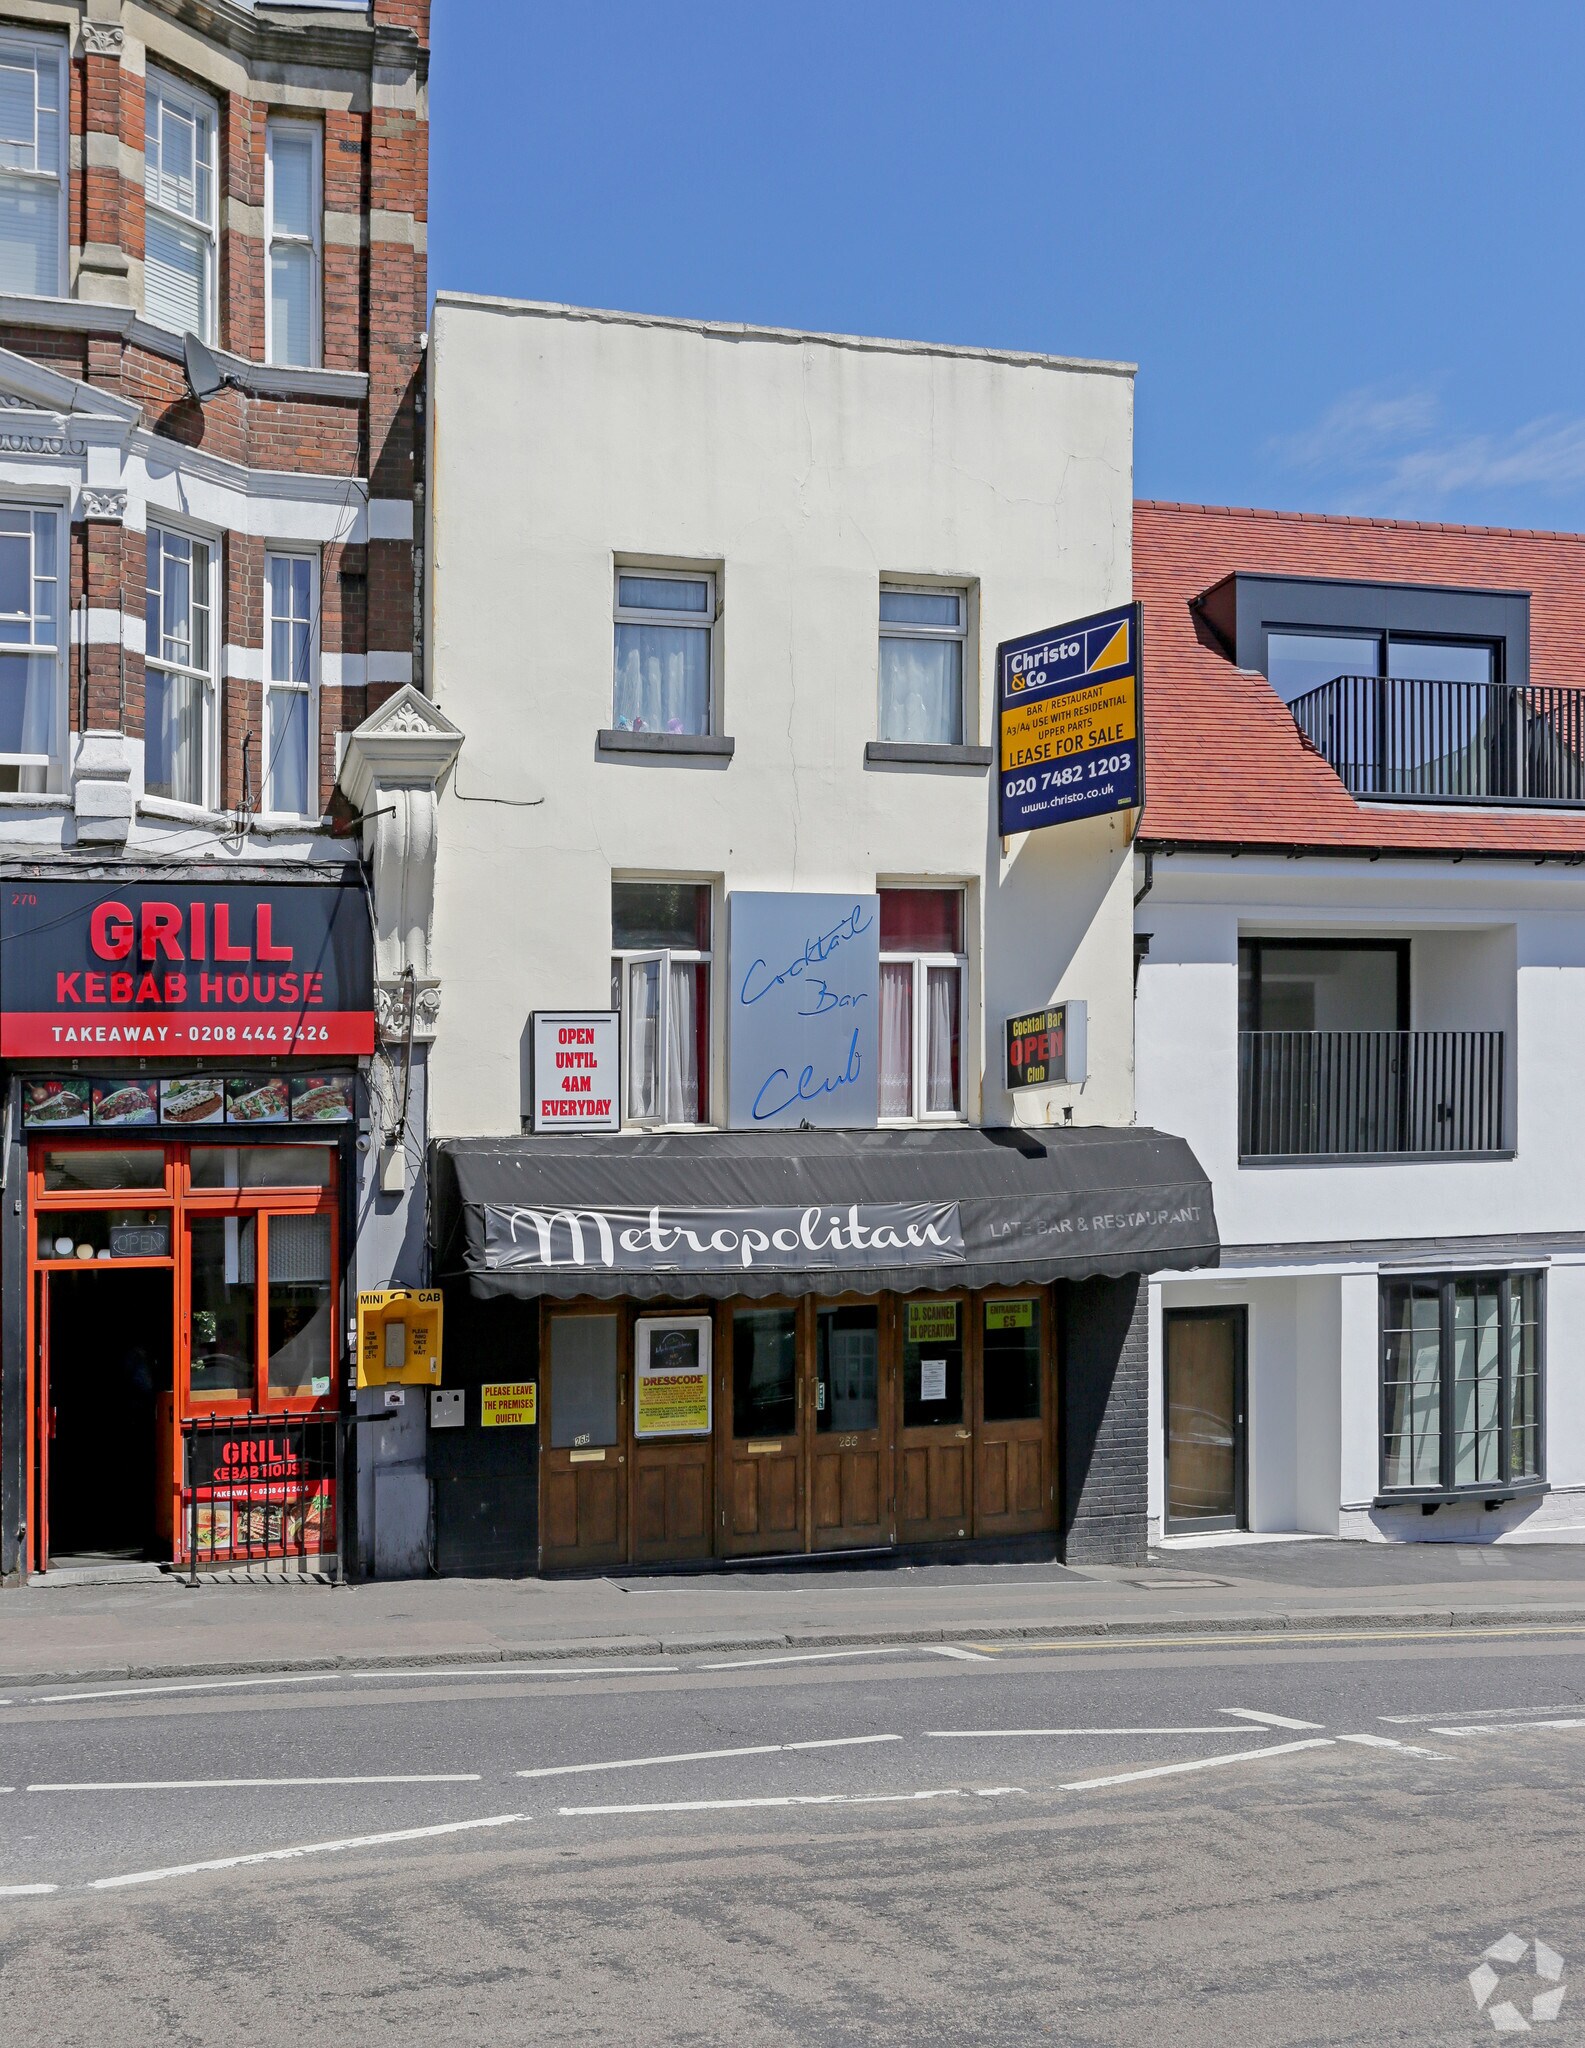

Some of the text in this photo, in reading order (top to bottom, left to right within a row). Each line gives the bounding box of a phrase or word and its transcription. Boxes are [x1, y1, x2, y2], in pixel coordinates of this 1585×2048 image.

[1011, 640, 1080, 672] Christo
[1011, 669, 1046, 691] &Co
[1026, 703, 1042, 716] BAR
[1051, 686, 1103, 710] RESTAURANT
[1006, 694, 1127, 736] A3/A4 USE WITH RESIDENTIAL
[1038, 718, 1093, 740] UPPER PARTS
[1009, 723, 1124, 768] LEASE FOR SALE
[1006, 753, 1131, 798] 020 7482 1203
[1021, 783, 1114, 814] www.christo.co.uk
[12, 893, 37, 905] 270
[90, 901, 293, 962] GRILL
[741, 905, 873, 1005] Cocktail
[56, 971, 323, 1004] KEBAB HOUSE
[798, 979, 867, 1015] Bar
[1013, 1011, 1063, 1037] Cocktail Bar
[52, 1026, 168, 1042] TAKEAWAY
[189, 1026, 236, 1042] 0208
[242, 1026, 277, 1041] 444
[283, 1026, 329, 1041] 2426
[558, 1028, 595, 1044] OPEN
[1010, 1030, 1064, 1067] OPEN
[555, 1052, 597, 1068] UNTIL
[752, 1028, 862, 1120] Club
[1027, 1065, 1045, 1083] Club
[561, 1076, 591, 1092] 4AM
[541, 1099, 611, 1116] EVERYDAY
[989, 1206, 1201, 1238] LATE BAR & RESTAURANT
[118, 1235, 160, 1251] OPEN
[510, 1205, 952, 1267] Metropolitan
[360, 1293, 440, 1304] MINI CAB
[910, 1305, 955, 1321] I.D. SCANNER
[990, 1304, 1028, 1314] ENTRANCE IS
[1003, 1315, 1016, 1327] £5
[910, 1323, 955, 1338] IN OPERATION
[643, 1374, 704, 1387] DRESSCODE
[485, 1385, 533, 1397] PLEASE LEAVE
[484, 1399, 534, 1410] THE PREMISES
[495, 1413, 523, 1424] QUIETLY
[575, 1433, 590, 1446] 266
[838, 1435, 858, 1447] 266
[222, 1438, 297, 1464] GRILL
